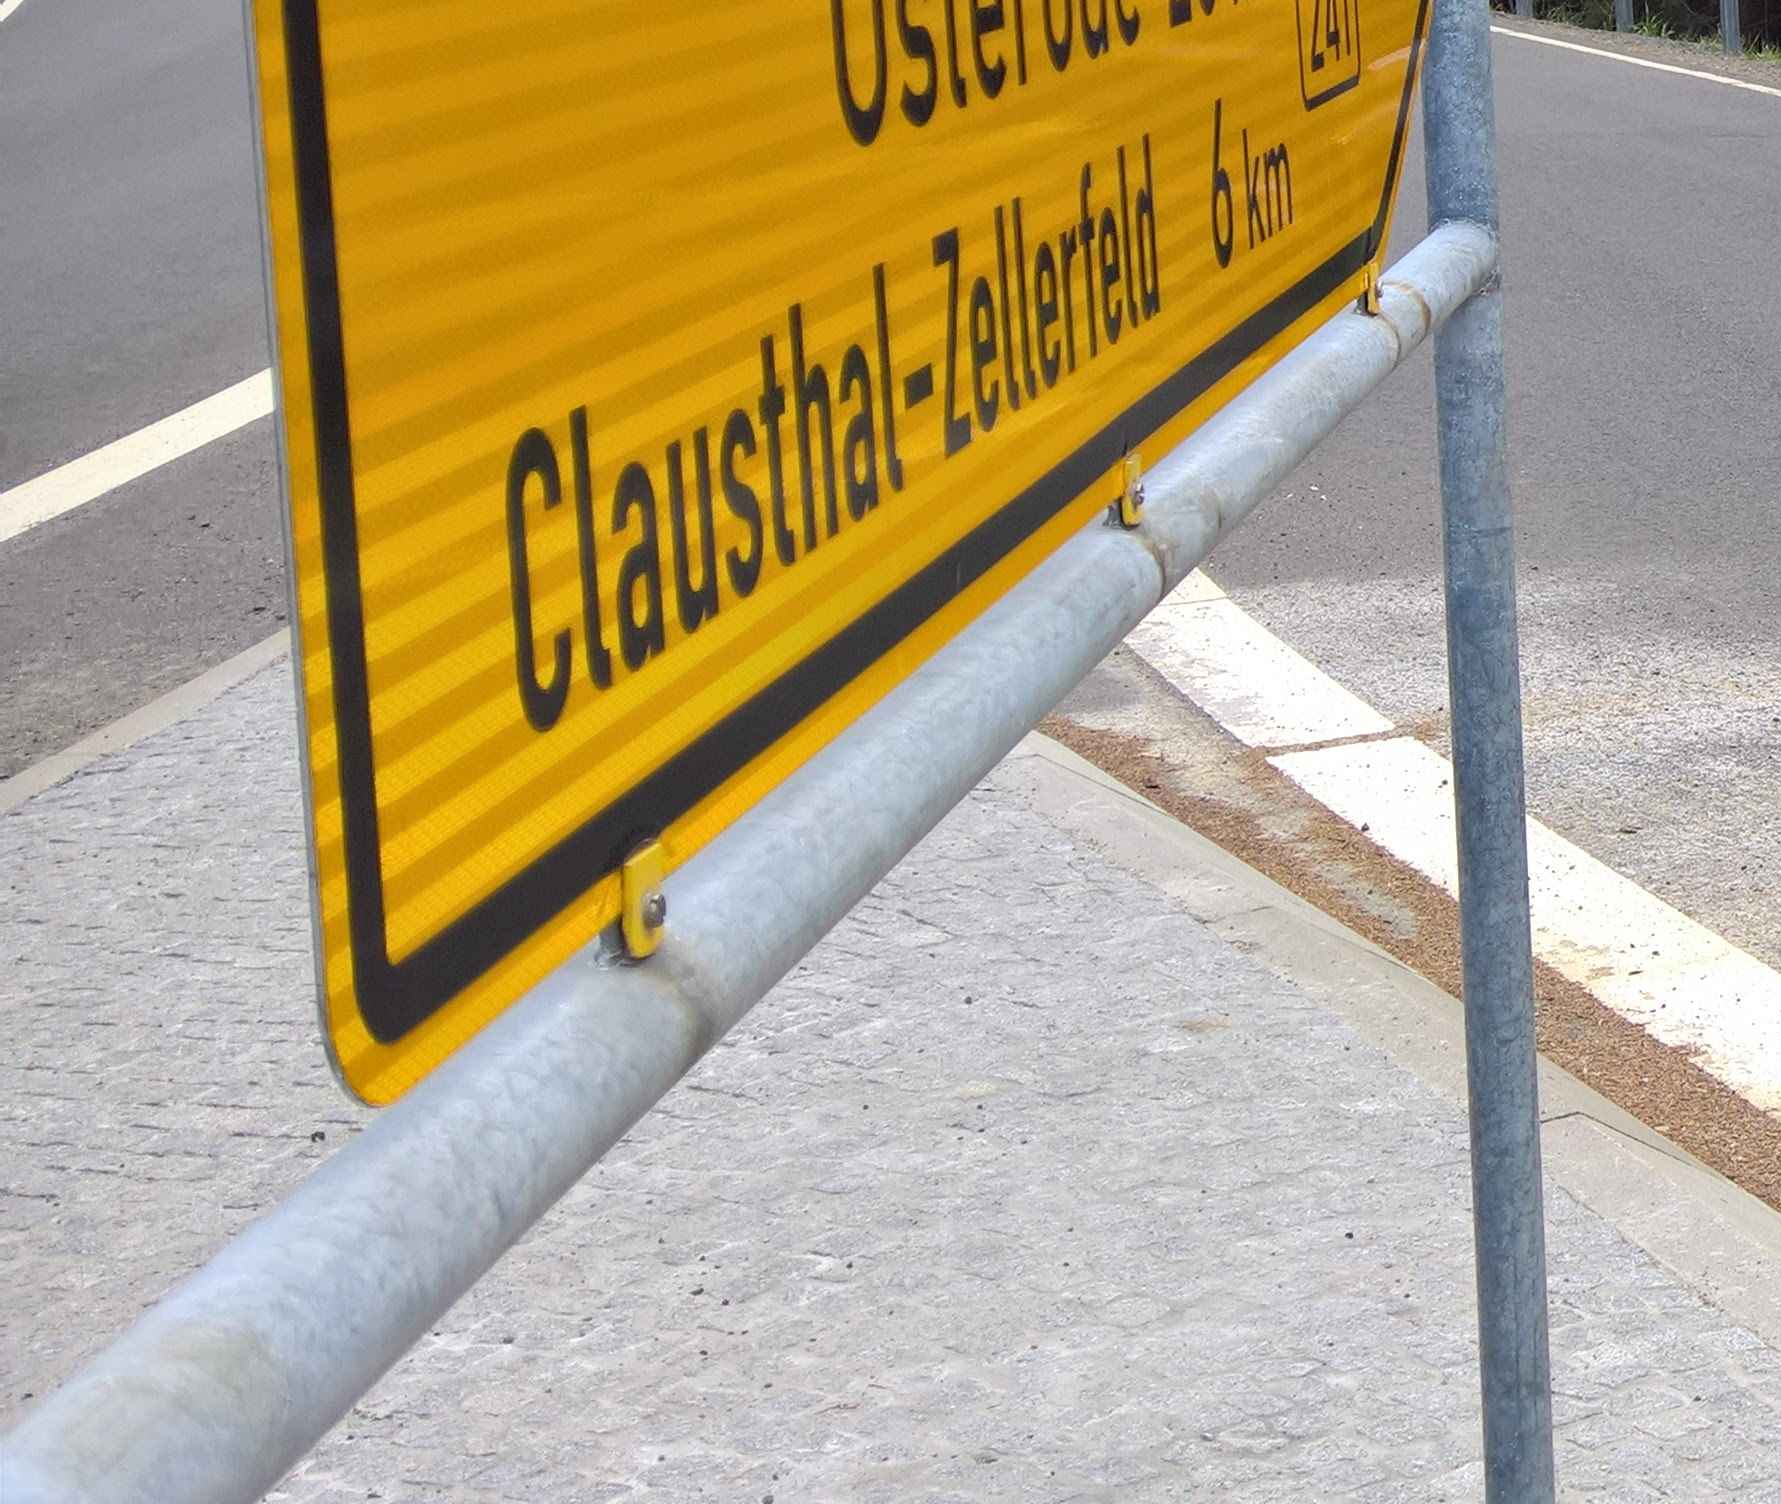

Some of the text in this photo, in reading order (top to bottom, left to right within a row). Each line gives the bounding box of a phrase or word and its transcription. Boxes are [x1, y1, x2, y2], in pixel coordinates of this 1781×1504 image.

[505, 97, 1294, 733] Clausthal-Zellerfeld 6 km
